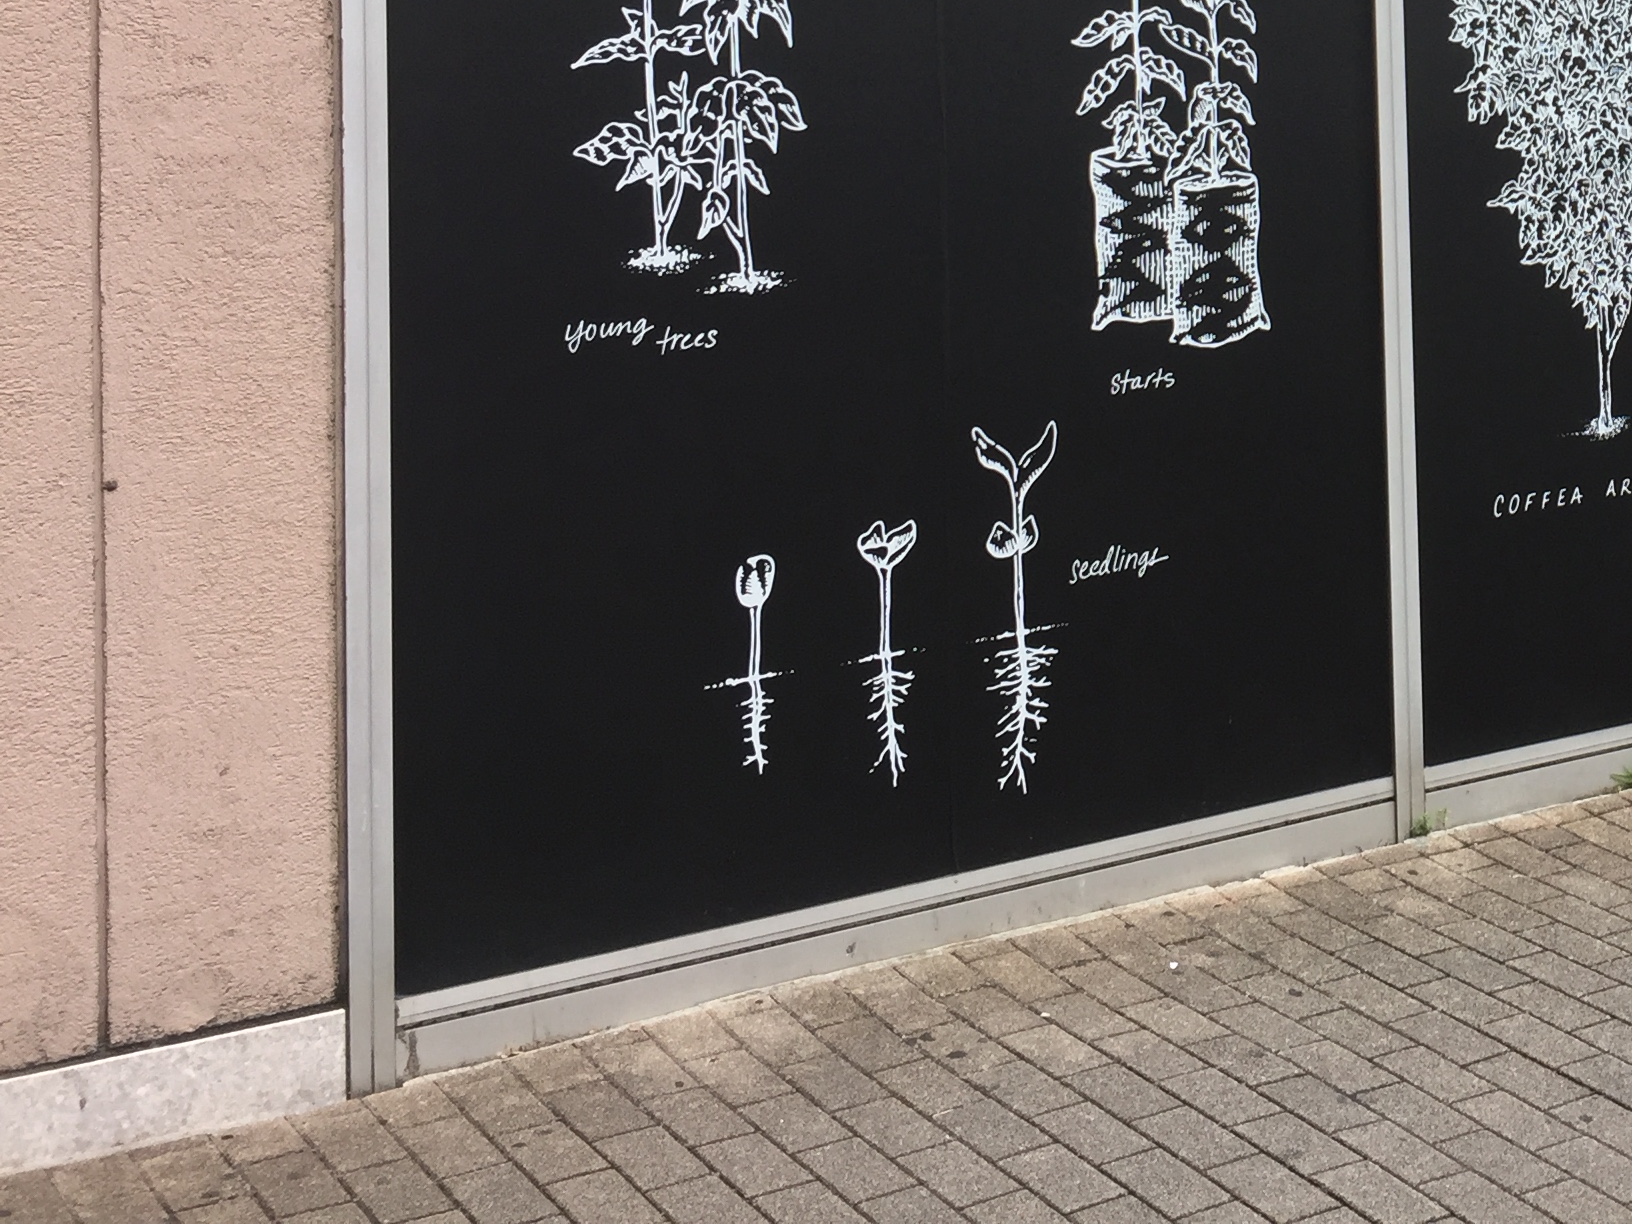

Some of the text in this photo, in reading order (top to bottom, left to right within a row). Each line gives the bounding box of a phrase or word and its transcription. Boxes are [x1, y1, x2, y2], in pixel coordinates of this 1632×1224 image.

[564, 317, 719, 356] young trees
[1110, 367, 1176, 395] starts
[1493, 486, 1584, 518] COFFEA
[1068, 544, 1170, 585] seedlings
